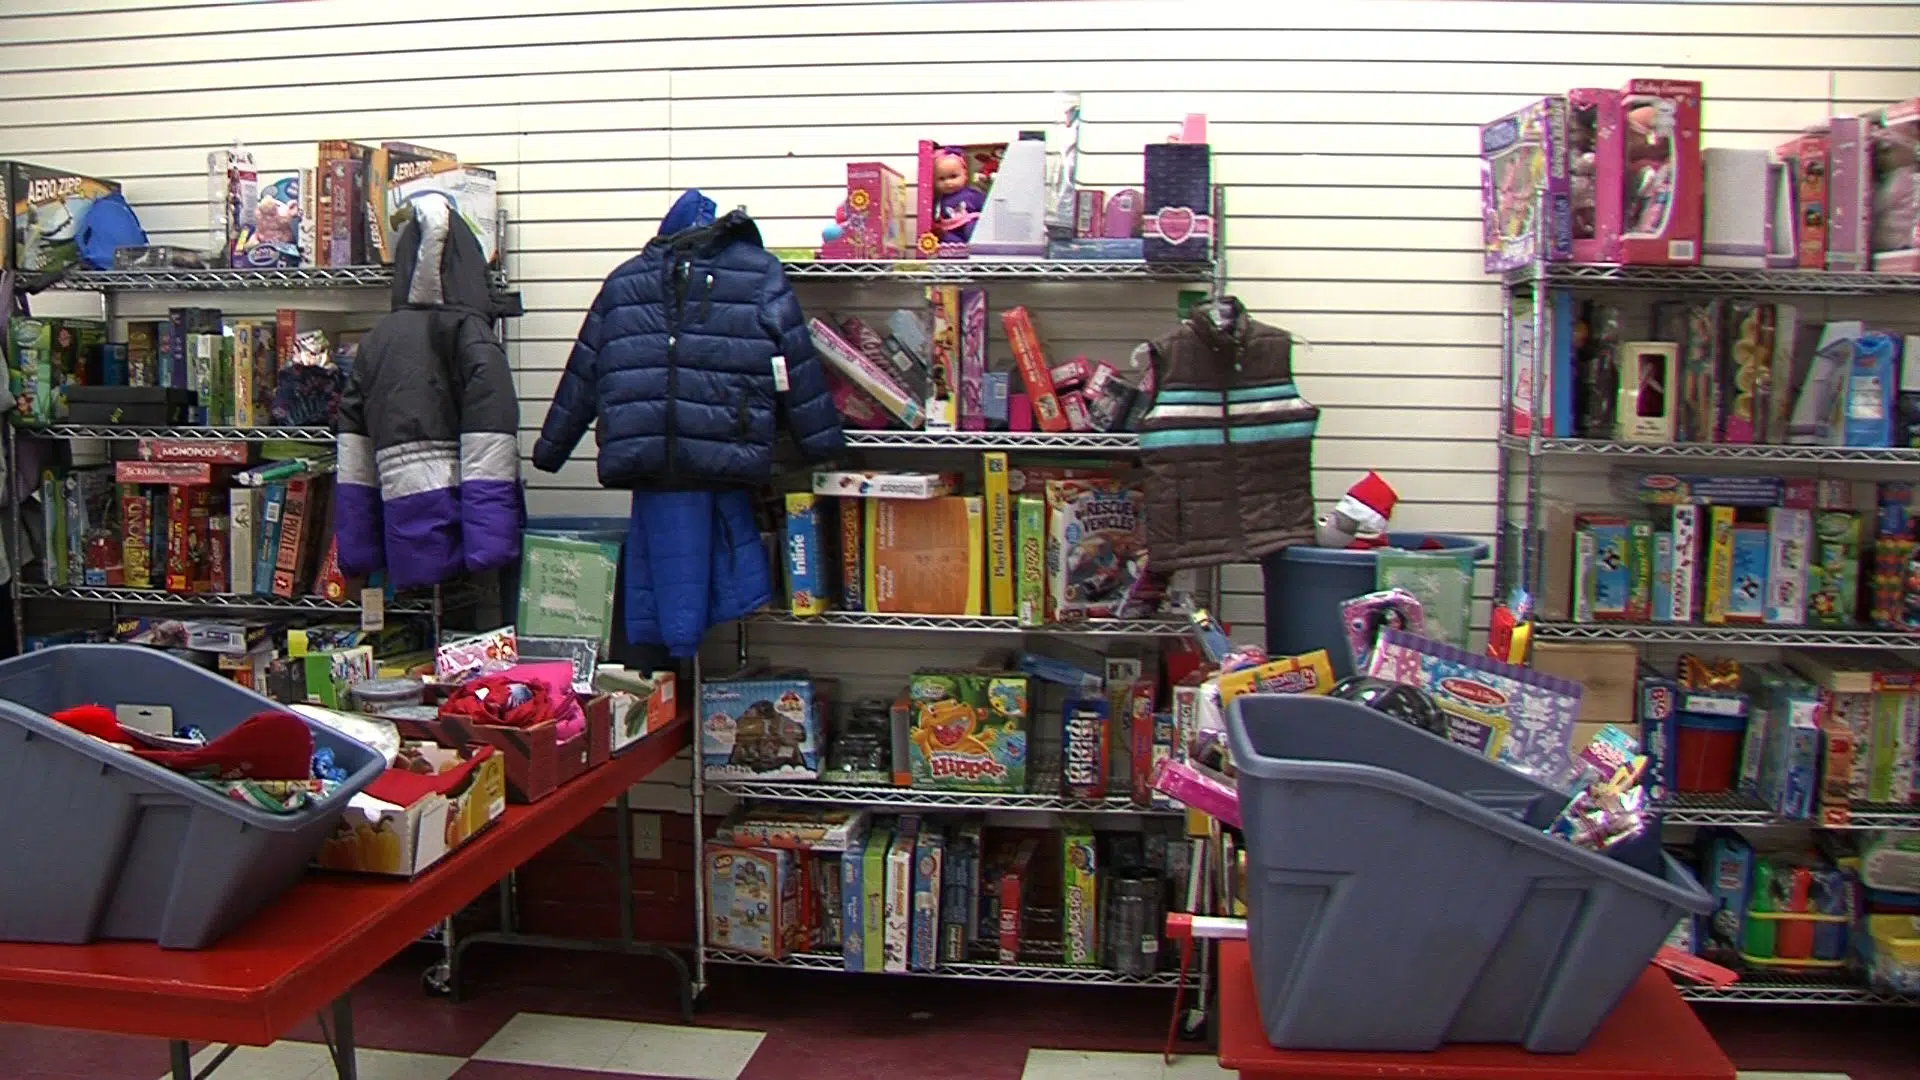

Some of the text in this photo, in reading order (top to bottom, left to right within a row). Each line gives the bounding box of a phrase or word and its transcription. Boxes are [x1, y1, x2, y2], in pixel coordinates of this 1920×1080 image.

[392, 162, 415, 183] AERO
[28, 178, 58, 202] AERO
[1086, 502, 1134, 516] RESCUE
[279, 516, 299, 552] PUZZLE
[1083, 515, 1135, 532] VEHICLES
[791, 533, 806, 576] Inline
[992, 538, 1005, 577] Playful
